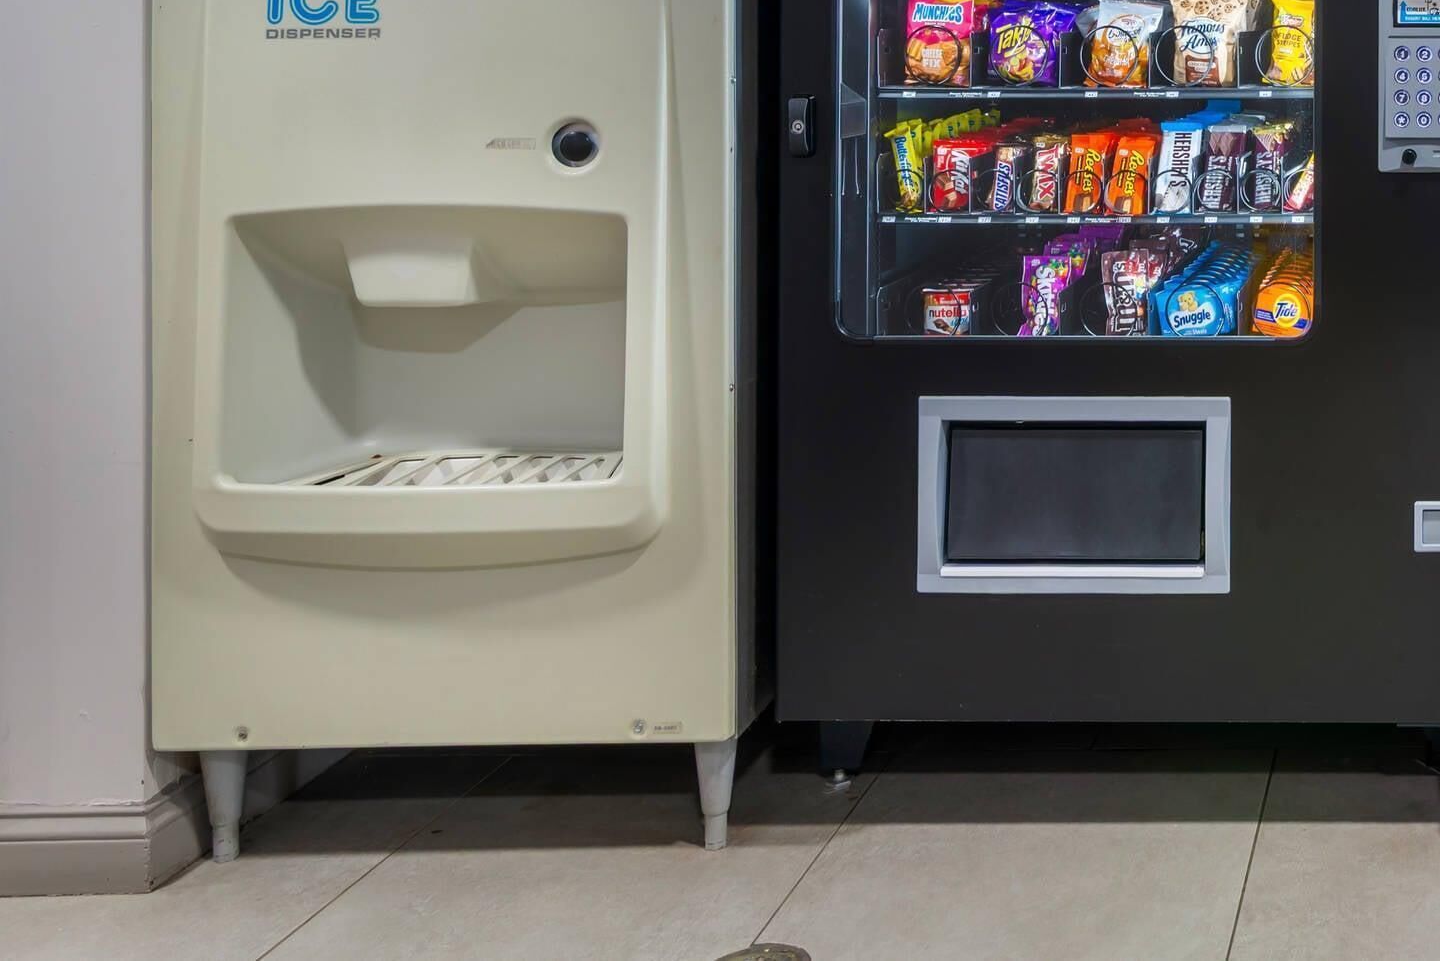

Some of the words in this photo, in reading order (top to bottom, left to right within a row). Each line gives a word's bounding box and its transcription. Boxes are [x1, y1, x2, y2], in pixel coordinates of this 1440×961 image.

[911, 2, 964, 24] MUNCHIES
[265, 28, 382, 39] DISPENSER
[1177, 20, 1225, 42] Famous
[1036, 143, 1060, 201] TWIX
[1081, 148, 1101, 194] Reese's
[1122, 149, 1145, 197] Reese's
[994, 161, 1012, 212] SATISFIES
[928, 305, 967, 319] nutella
[1173, 308, 1212, 328] Snuggle
[1275, 301, 1298, 319] Tide
